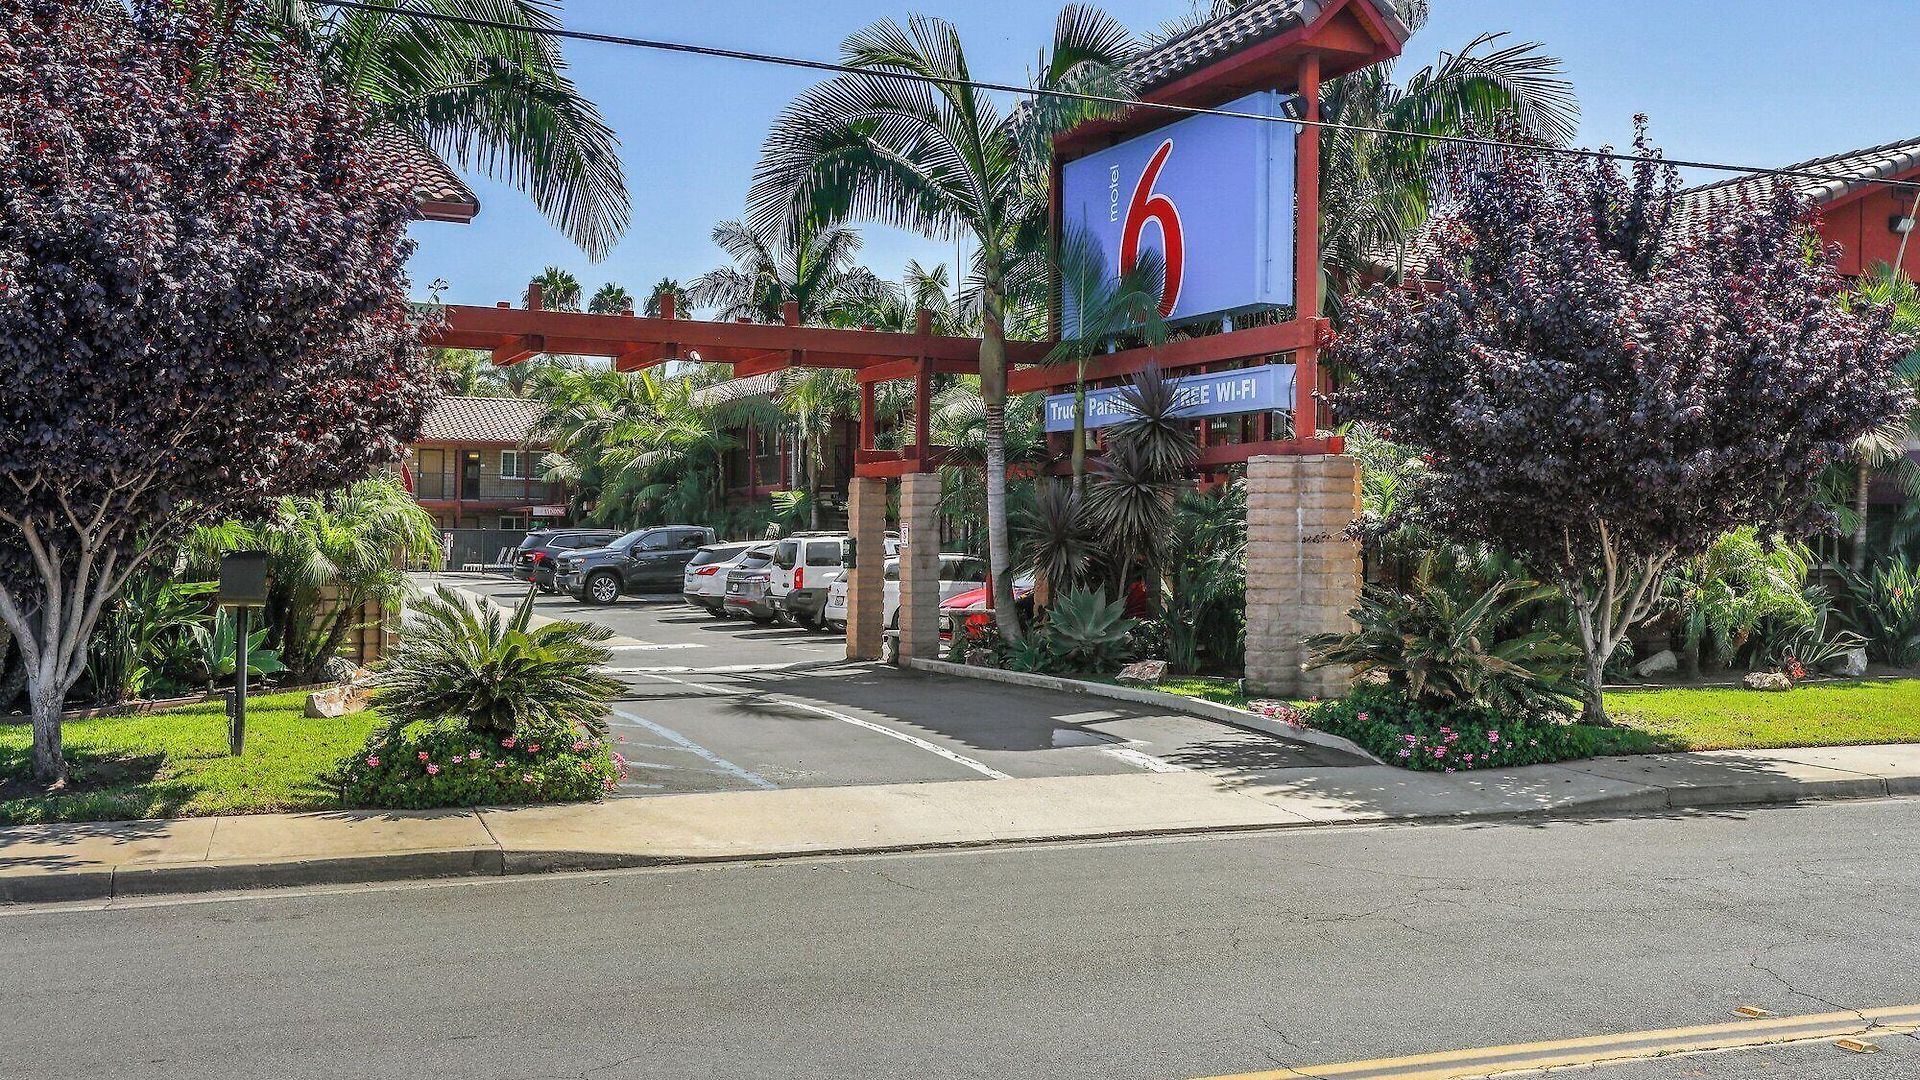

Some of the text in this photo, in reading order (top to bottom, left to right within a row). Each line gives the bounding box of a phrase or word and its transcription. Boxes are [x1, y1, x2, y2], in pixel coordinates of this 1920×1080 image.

[1109, 164, 1119, 222] motel
[1118, 137, 1187, 321] 6
[1051, 402, 1077, 421] Truc
[1216, 378, 1256, 402] WI-FI
